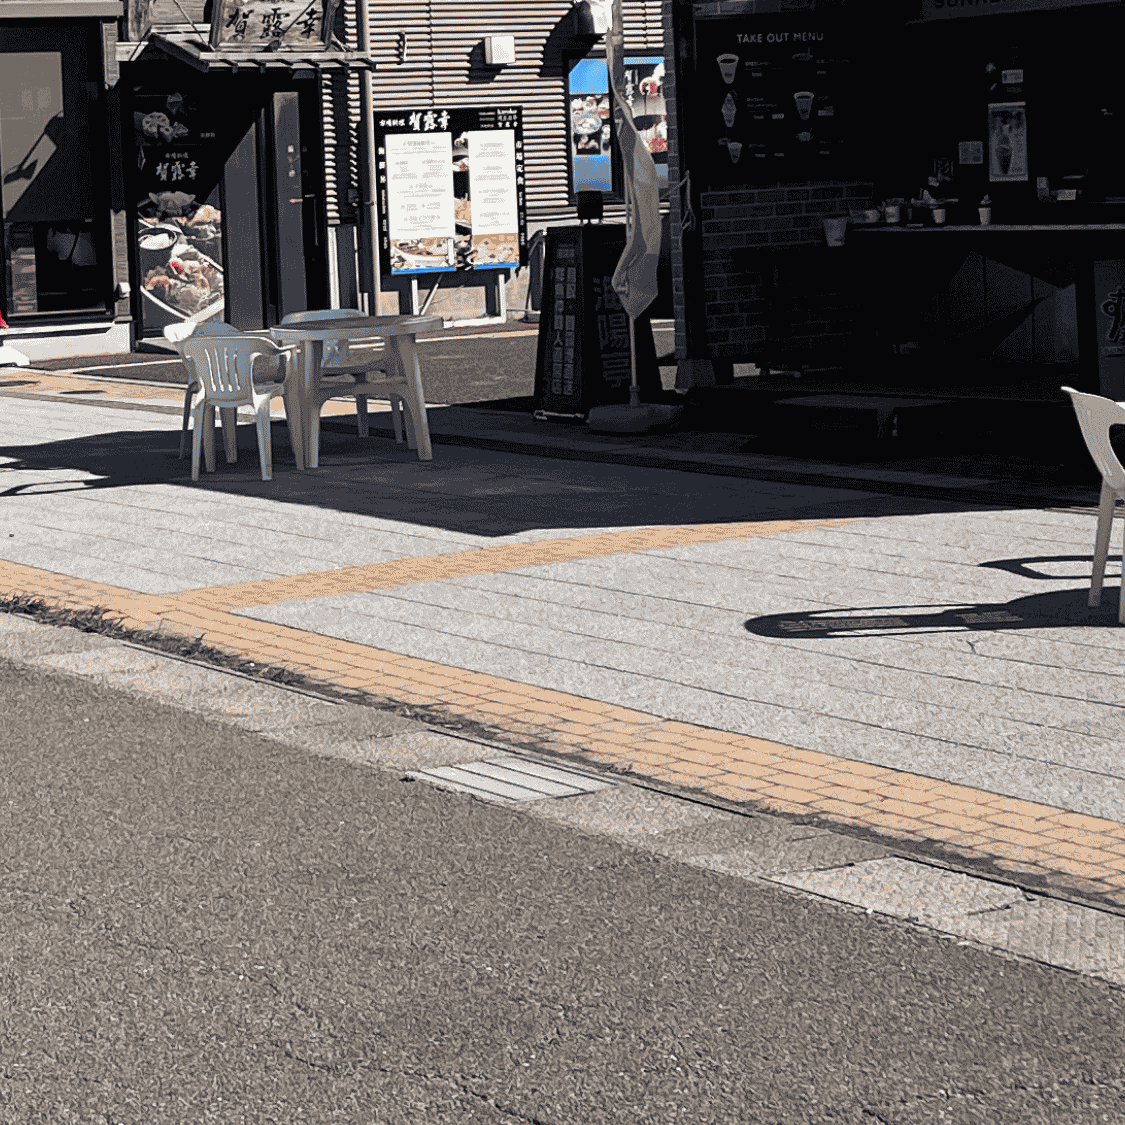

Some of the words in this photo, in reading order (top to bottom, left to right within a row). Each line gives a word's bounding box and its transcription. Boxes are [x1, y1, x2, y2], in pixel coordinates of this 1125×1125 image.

[736, 33, 764, 44] TAKE
[766, 33, 790, 43] OUT
[792, 31, 825, 42] MENU
